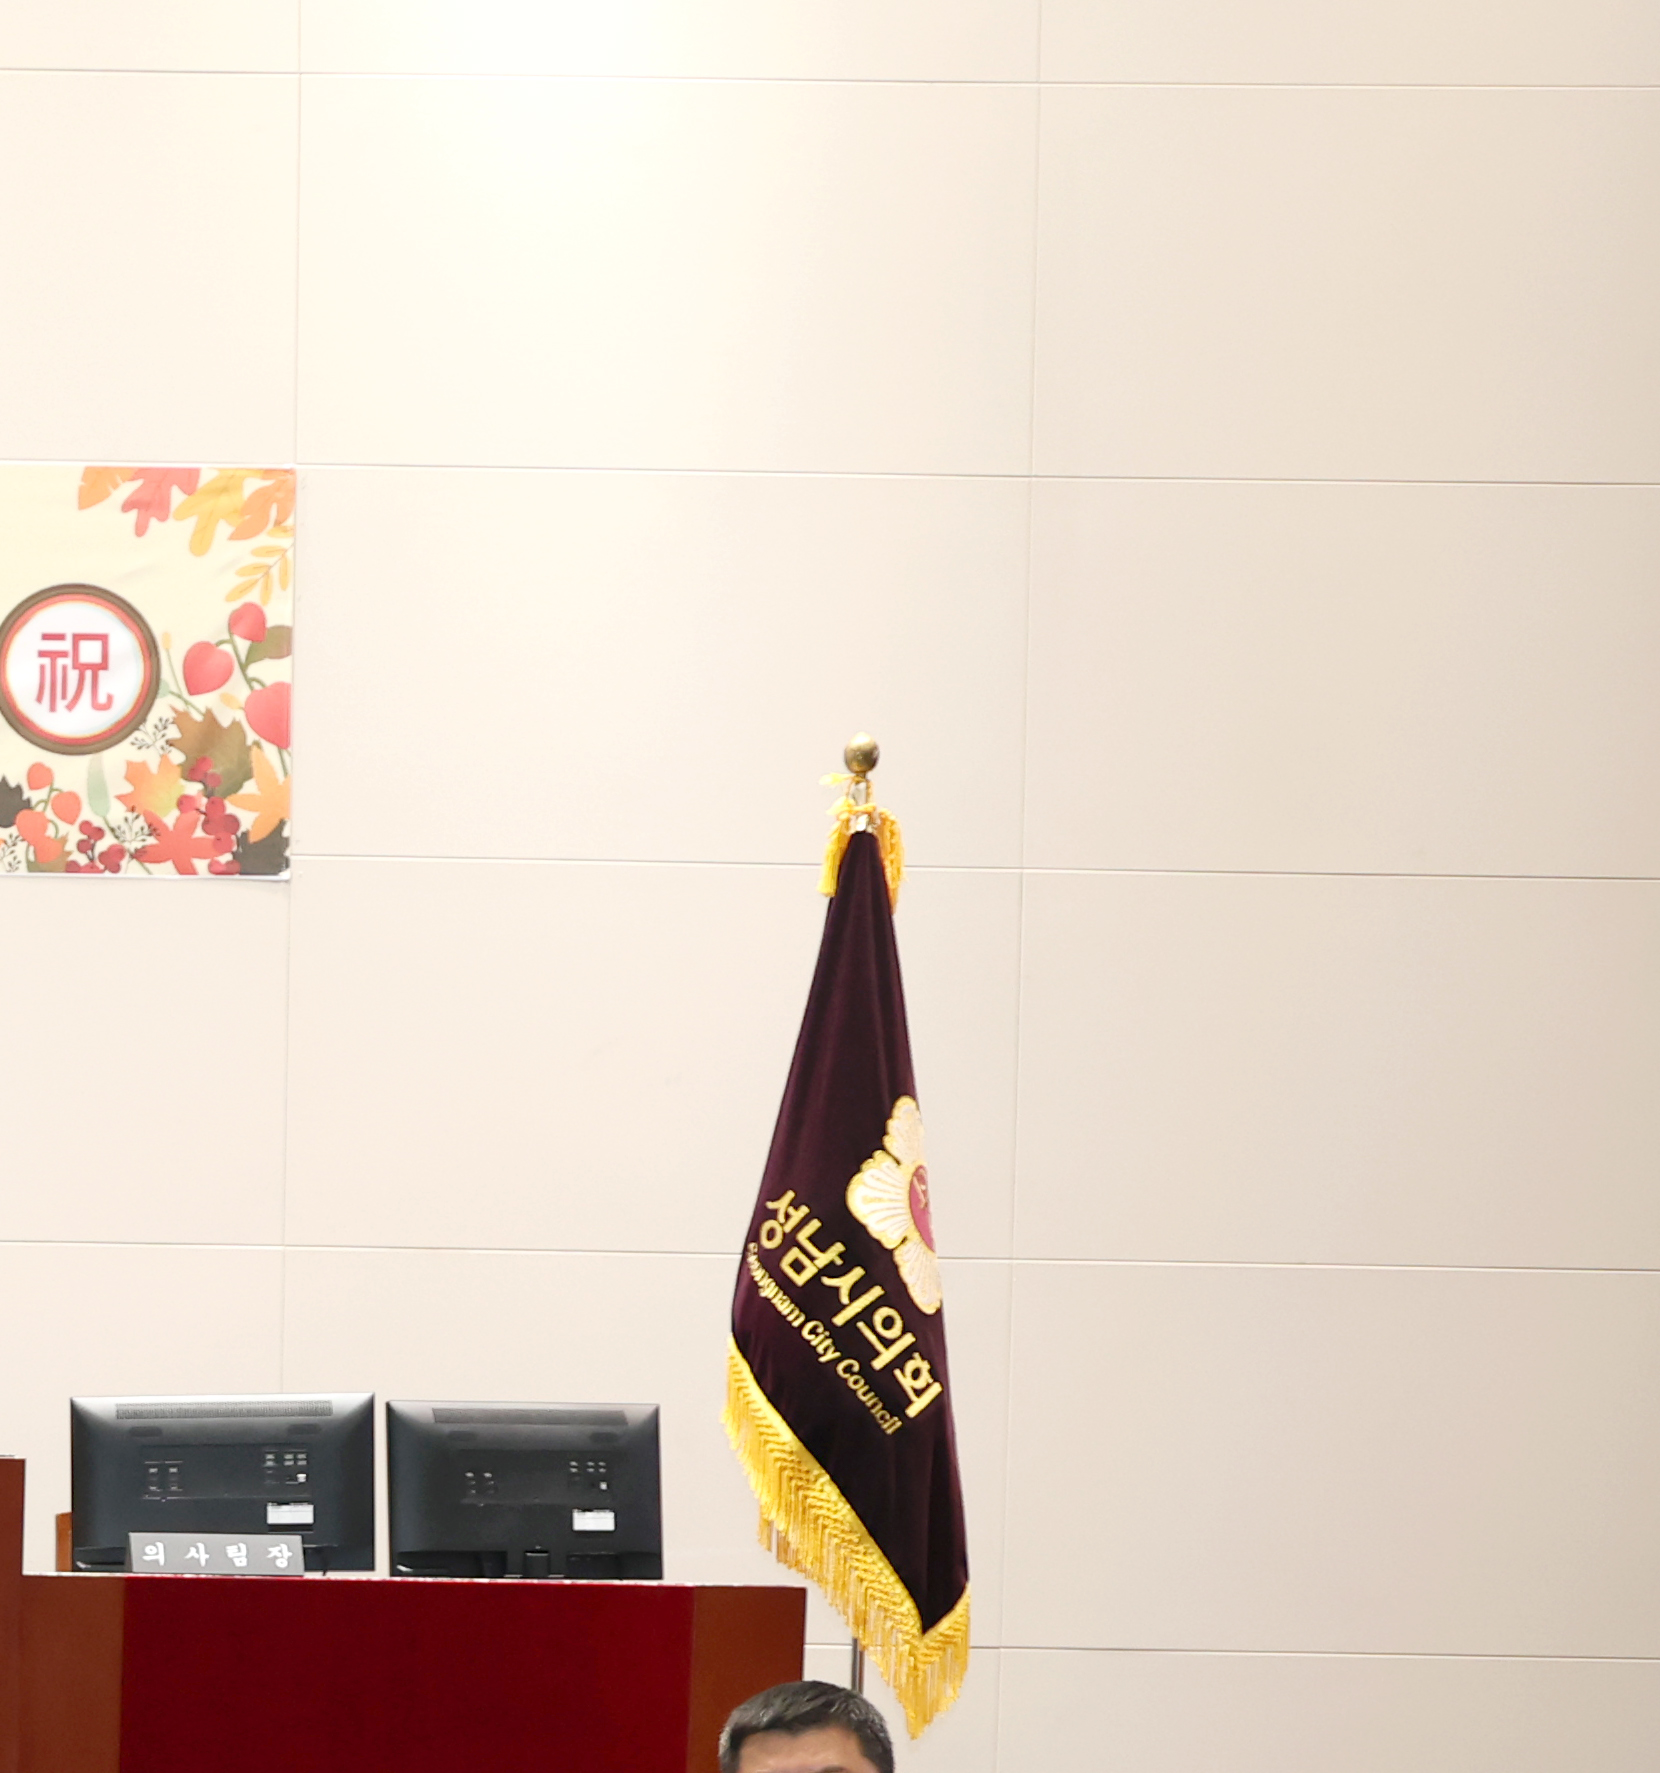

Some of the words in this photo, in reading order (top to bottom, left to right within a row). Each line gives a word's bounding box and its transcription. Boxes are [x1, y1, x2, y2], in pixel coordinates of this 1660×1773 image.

[35, 631, 113, 714] 祝
[758, 1189, 943, 1418] 성남시의회
[801, 1320, 842, 1363] City
[835, 1358, 903, 1435] Council
